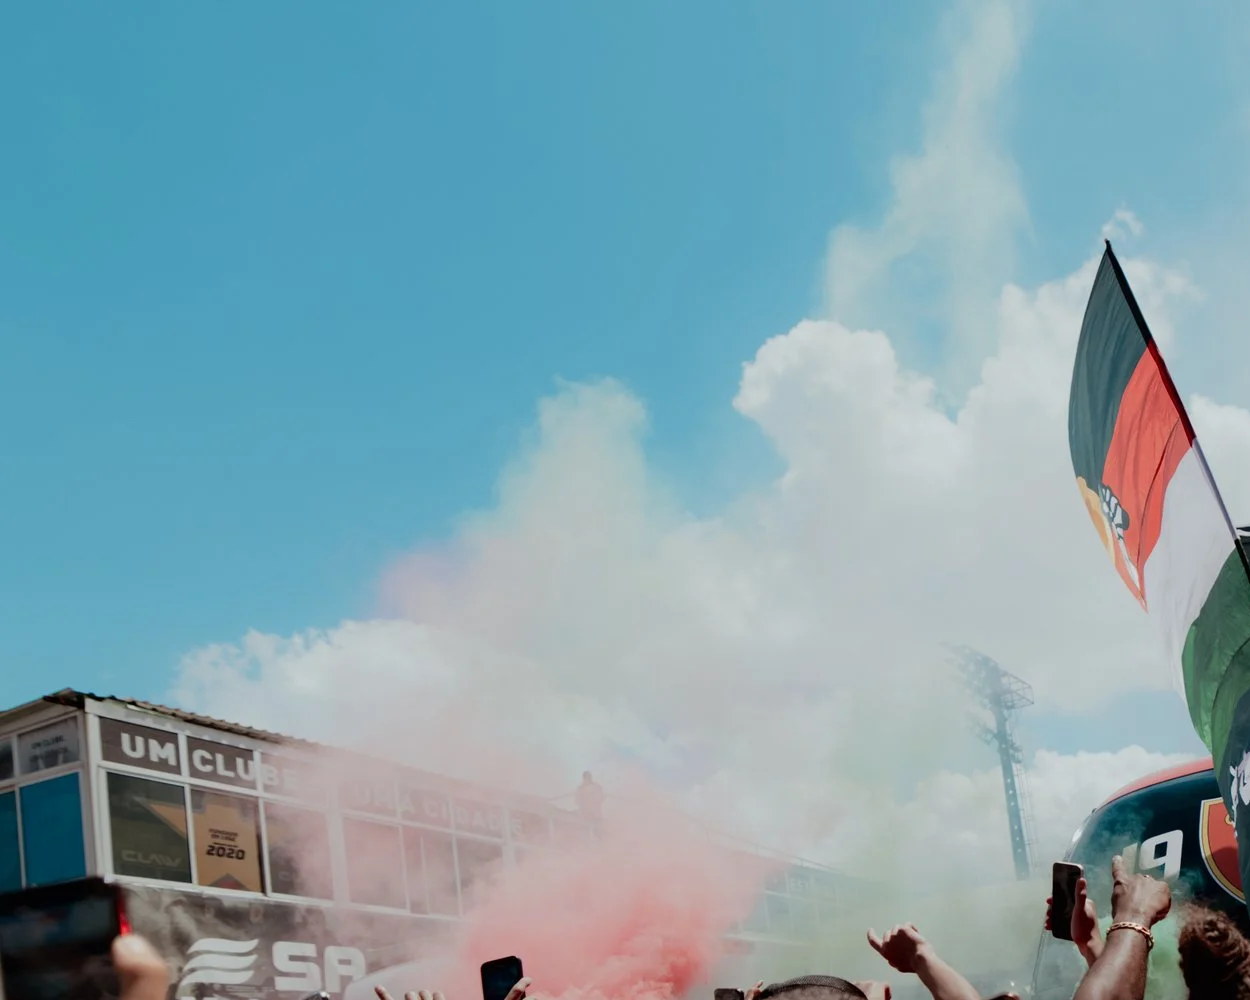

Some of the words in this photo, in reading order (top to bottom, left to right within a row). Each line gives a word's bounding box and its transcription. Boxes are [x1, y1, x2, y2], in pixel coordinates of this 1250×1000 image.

[120, 731, 178, 767] UM
[191, 748, 302, 792] CLUBE
[205, 843, 246, 861] 2020
